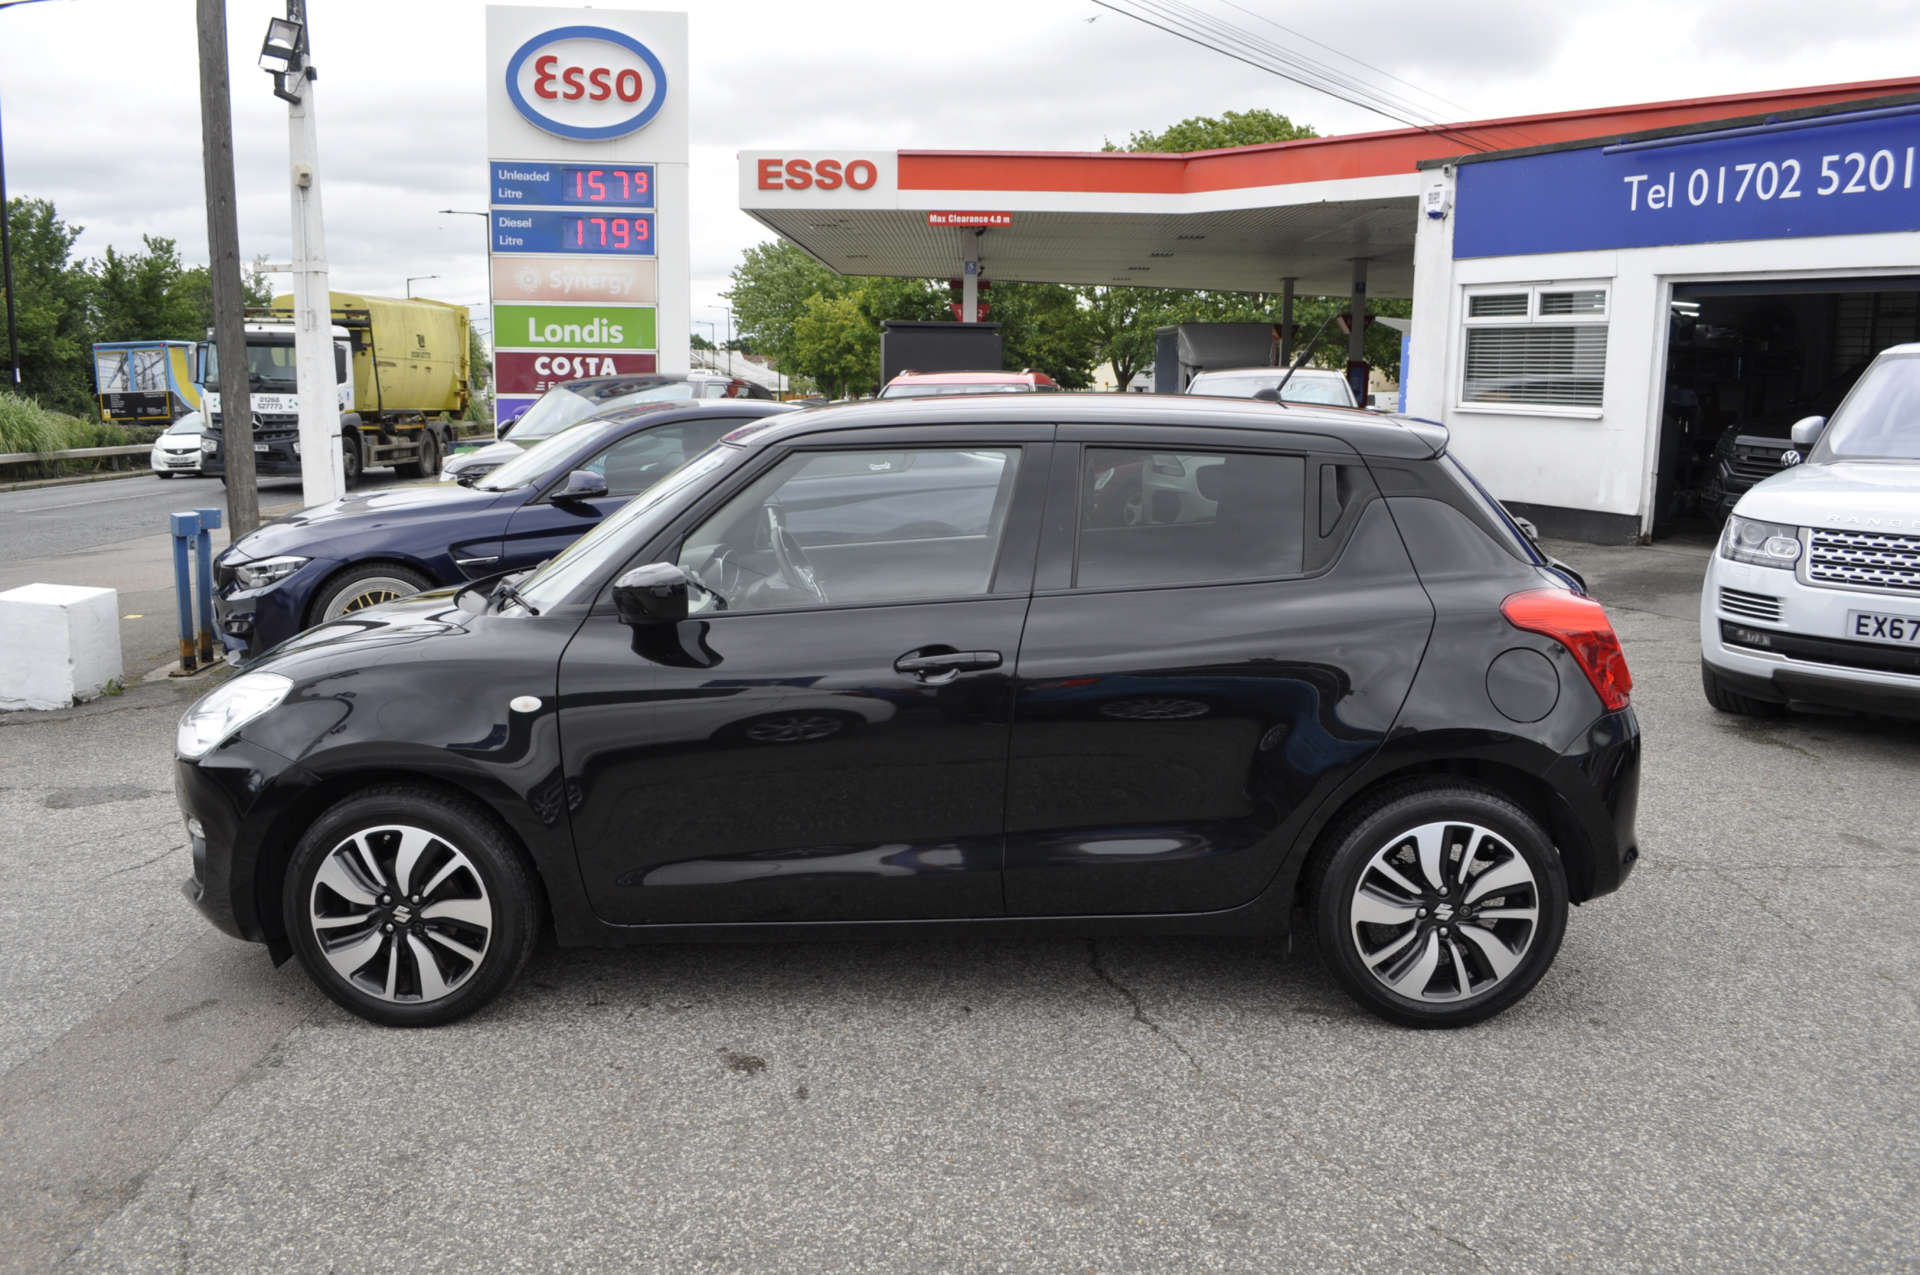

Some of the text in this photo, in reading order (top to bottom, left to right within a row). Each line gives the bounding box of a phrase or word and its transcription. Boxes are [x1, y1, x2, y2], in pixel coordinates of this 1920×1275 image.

[498, 169, 550, 182] Unleaded
[757, 158, 877, 190] ESSO
[1624, 147, 1914, 211] Tel 01702 5201
[498, 187, 523, 199] Litre
[498, 217, 532, 229] Diesel
[929, 214, 946, 223] Max
[948, 214, 988, 223] Clearance
[499, 235, 524, 246] Litre
[549, 269, 634, 295] Synergy
[528, 317, 624, 344] Londis
[534, 356, 618, 378] COSTA
[1855, 614, 1920, 641] EX67
